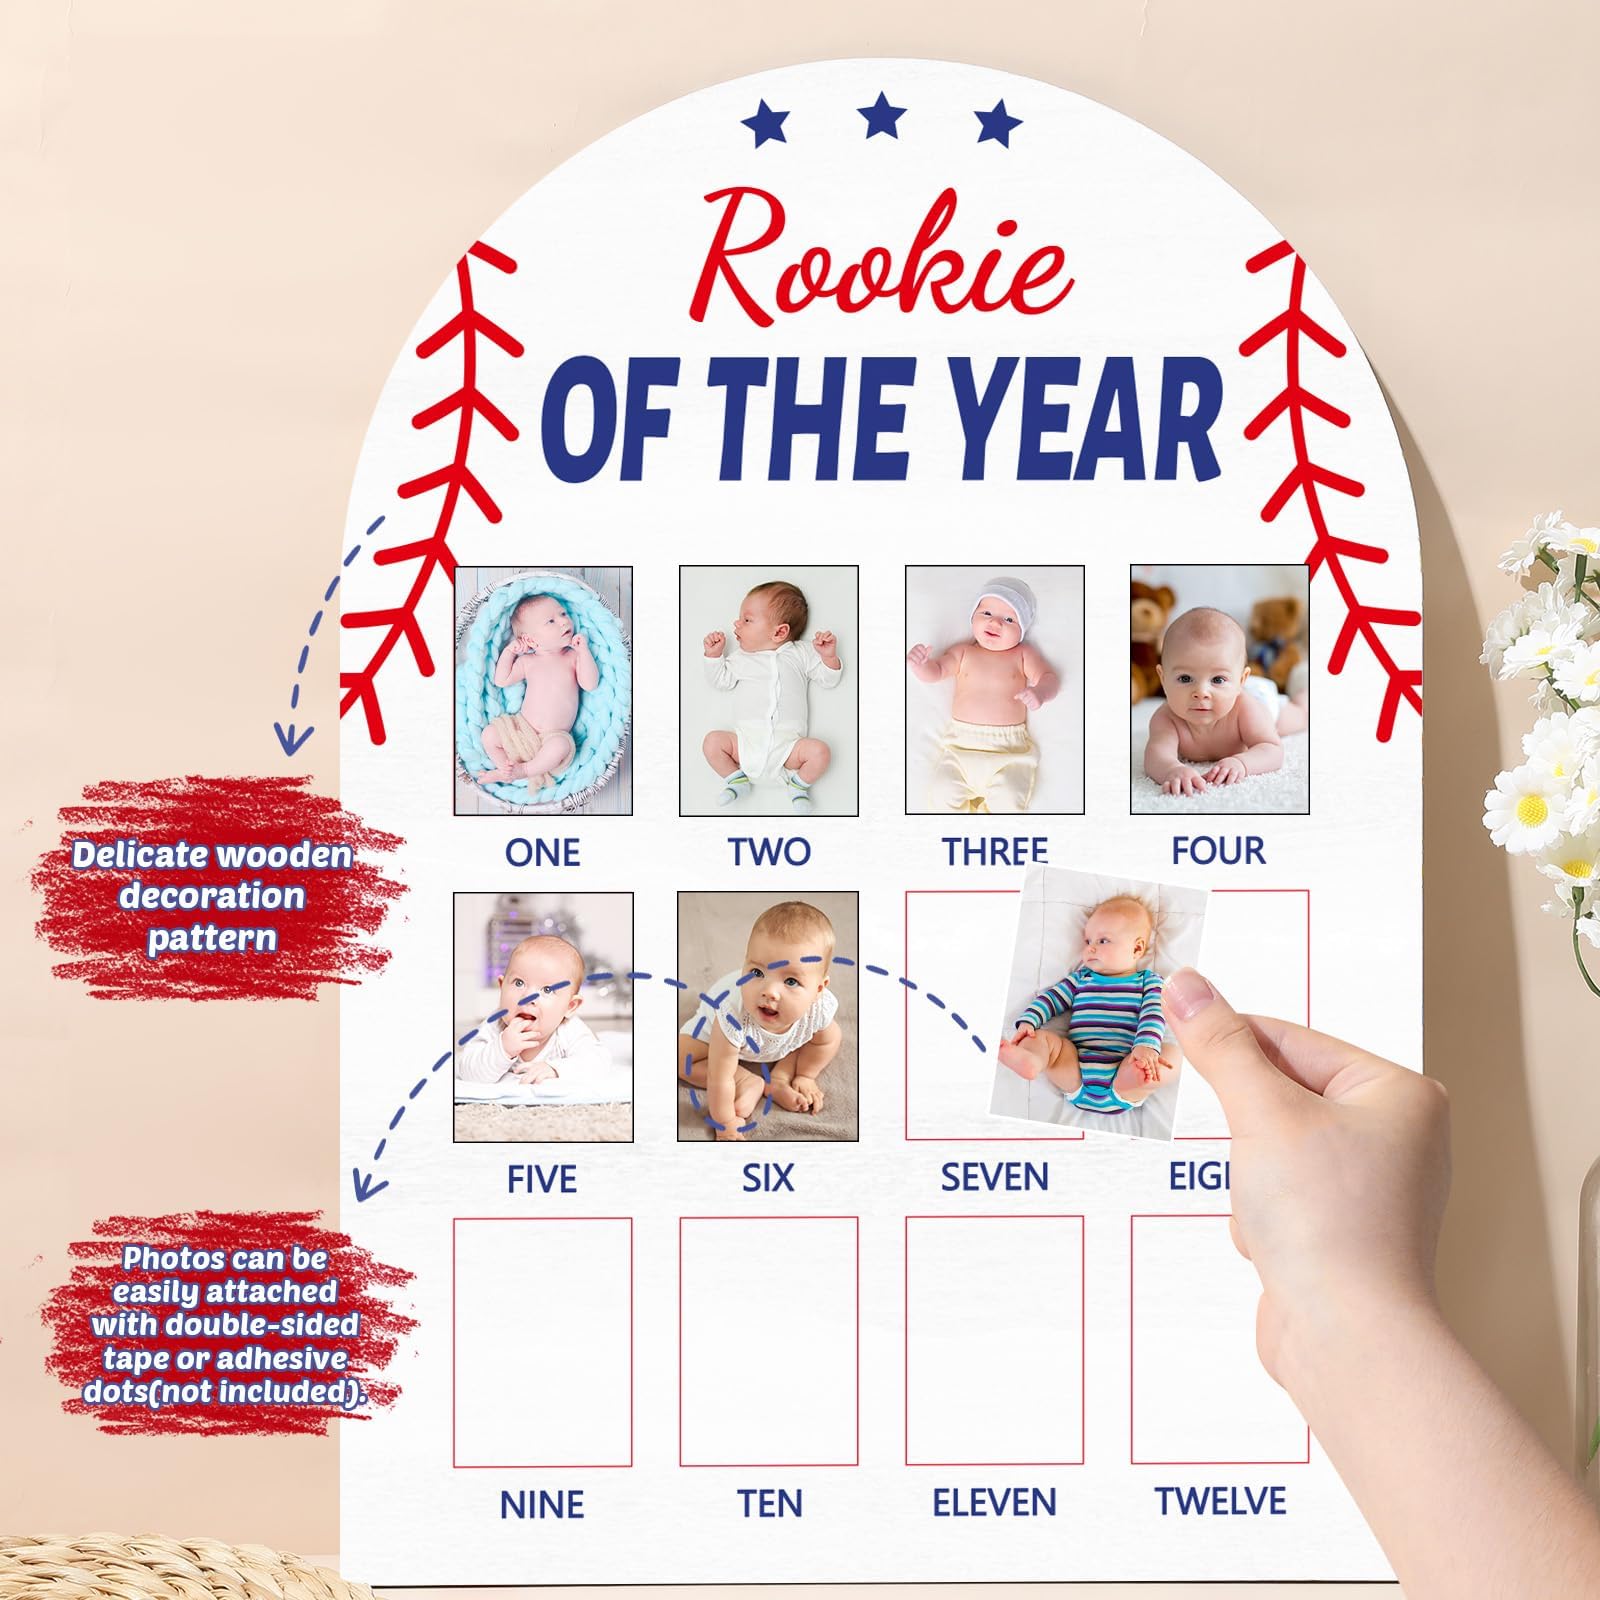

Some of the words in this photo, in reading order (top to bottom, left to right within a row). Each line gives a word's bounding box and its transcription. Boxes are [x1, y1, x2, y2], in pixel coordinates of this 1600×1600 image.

[689, 187, 1074, 327] Rookie
[542, 355, 680, 483] OF
[708, 357, 917, 480] THE
[948, 356, 1223, 482] YEAR
[506, 838, 578, 867] ONE
[728, 837, 811, 866] TWO
[944, 837, 1049, 865] THREE
[1173, 836, 1264, 864] FOUR
[509, 1165, 576, 1193] FIVE
[743, 1163, 793, 1192] SIX
[943, 1162, 1048, 1191] SEVEN
[1170, 1161, 1229, 1190] EIG
[501, 1490, 583, 1519] NINE
[737, 1489, 802, 1517] TEN
[934, 1488, 1056, 1517] ELEVEN
[1155, 1487, 1285, 1515] TWELVE
